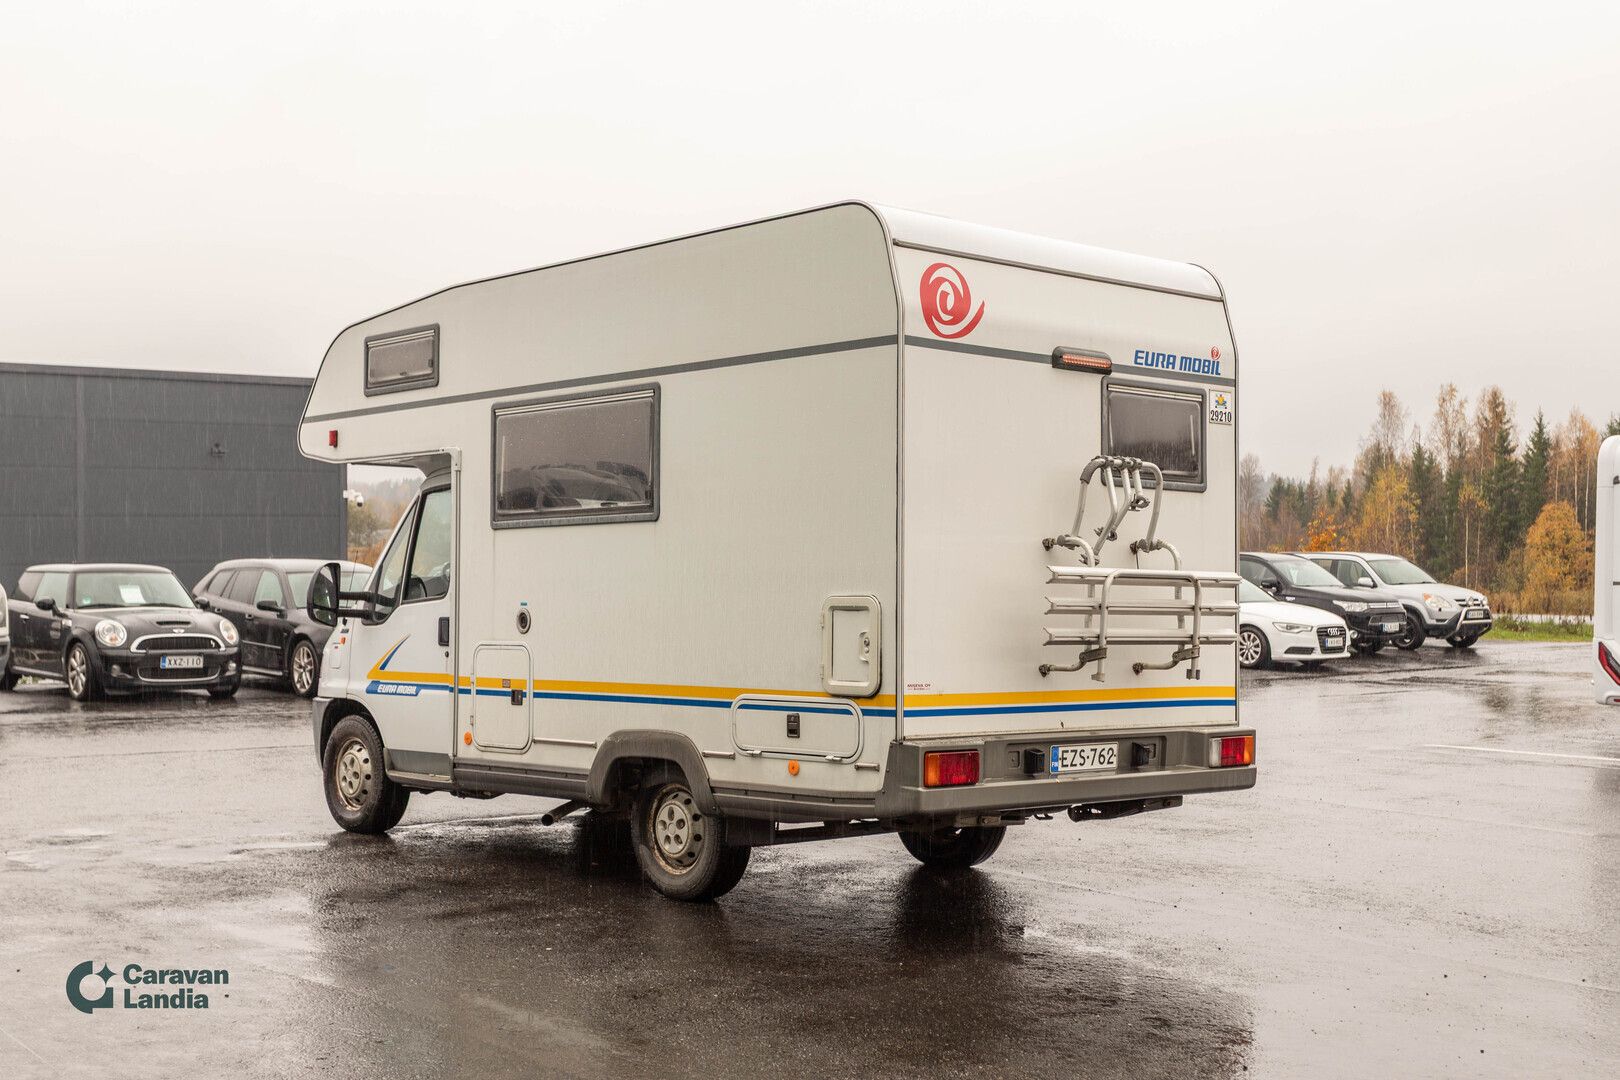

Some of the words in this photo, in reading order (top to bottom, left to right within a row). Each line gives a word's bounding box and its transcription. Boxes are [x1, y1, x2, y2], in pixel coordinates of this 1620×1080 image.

[1134, 349, 1177, 370] EURA
[1179, 355, 1221, 376] MOBIL
[1210, 409, 1232, 423] 29210
[1060, 747, 1115, 768] EZS-762
